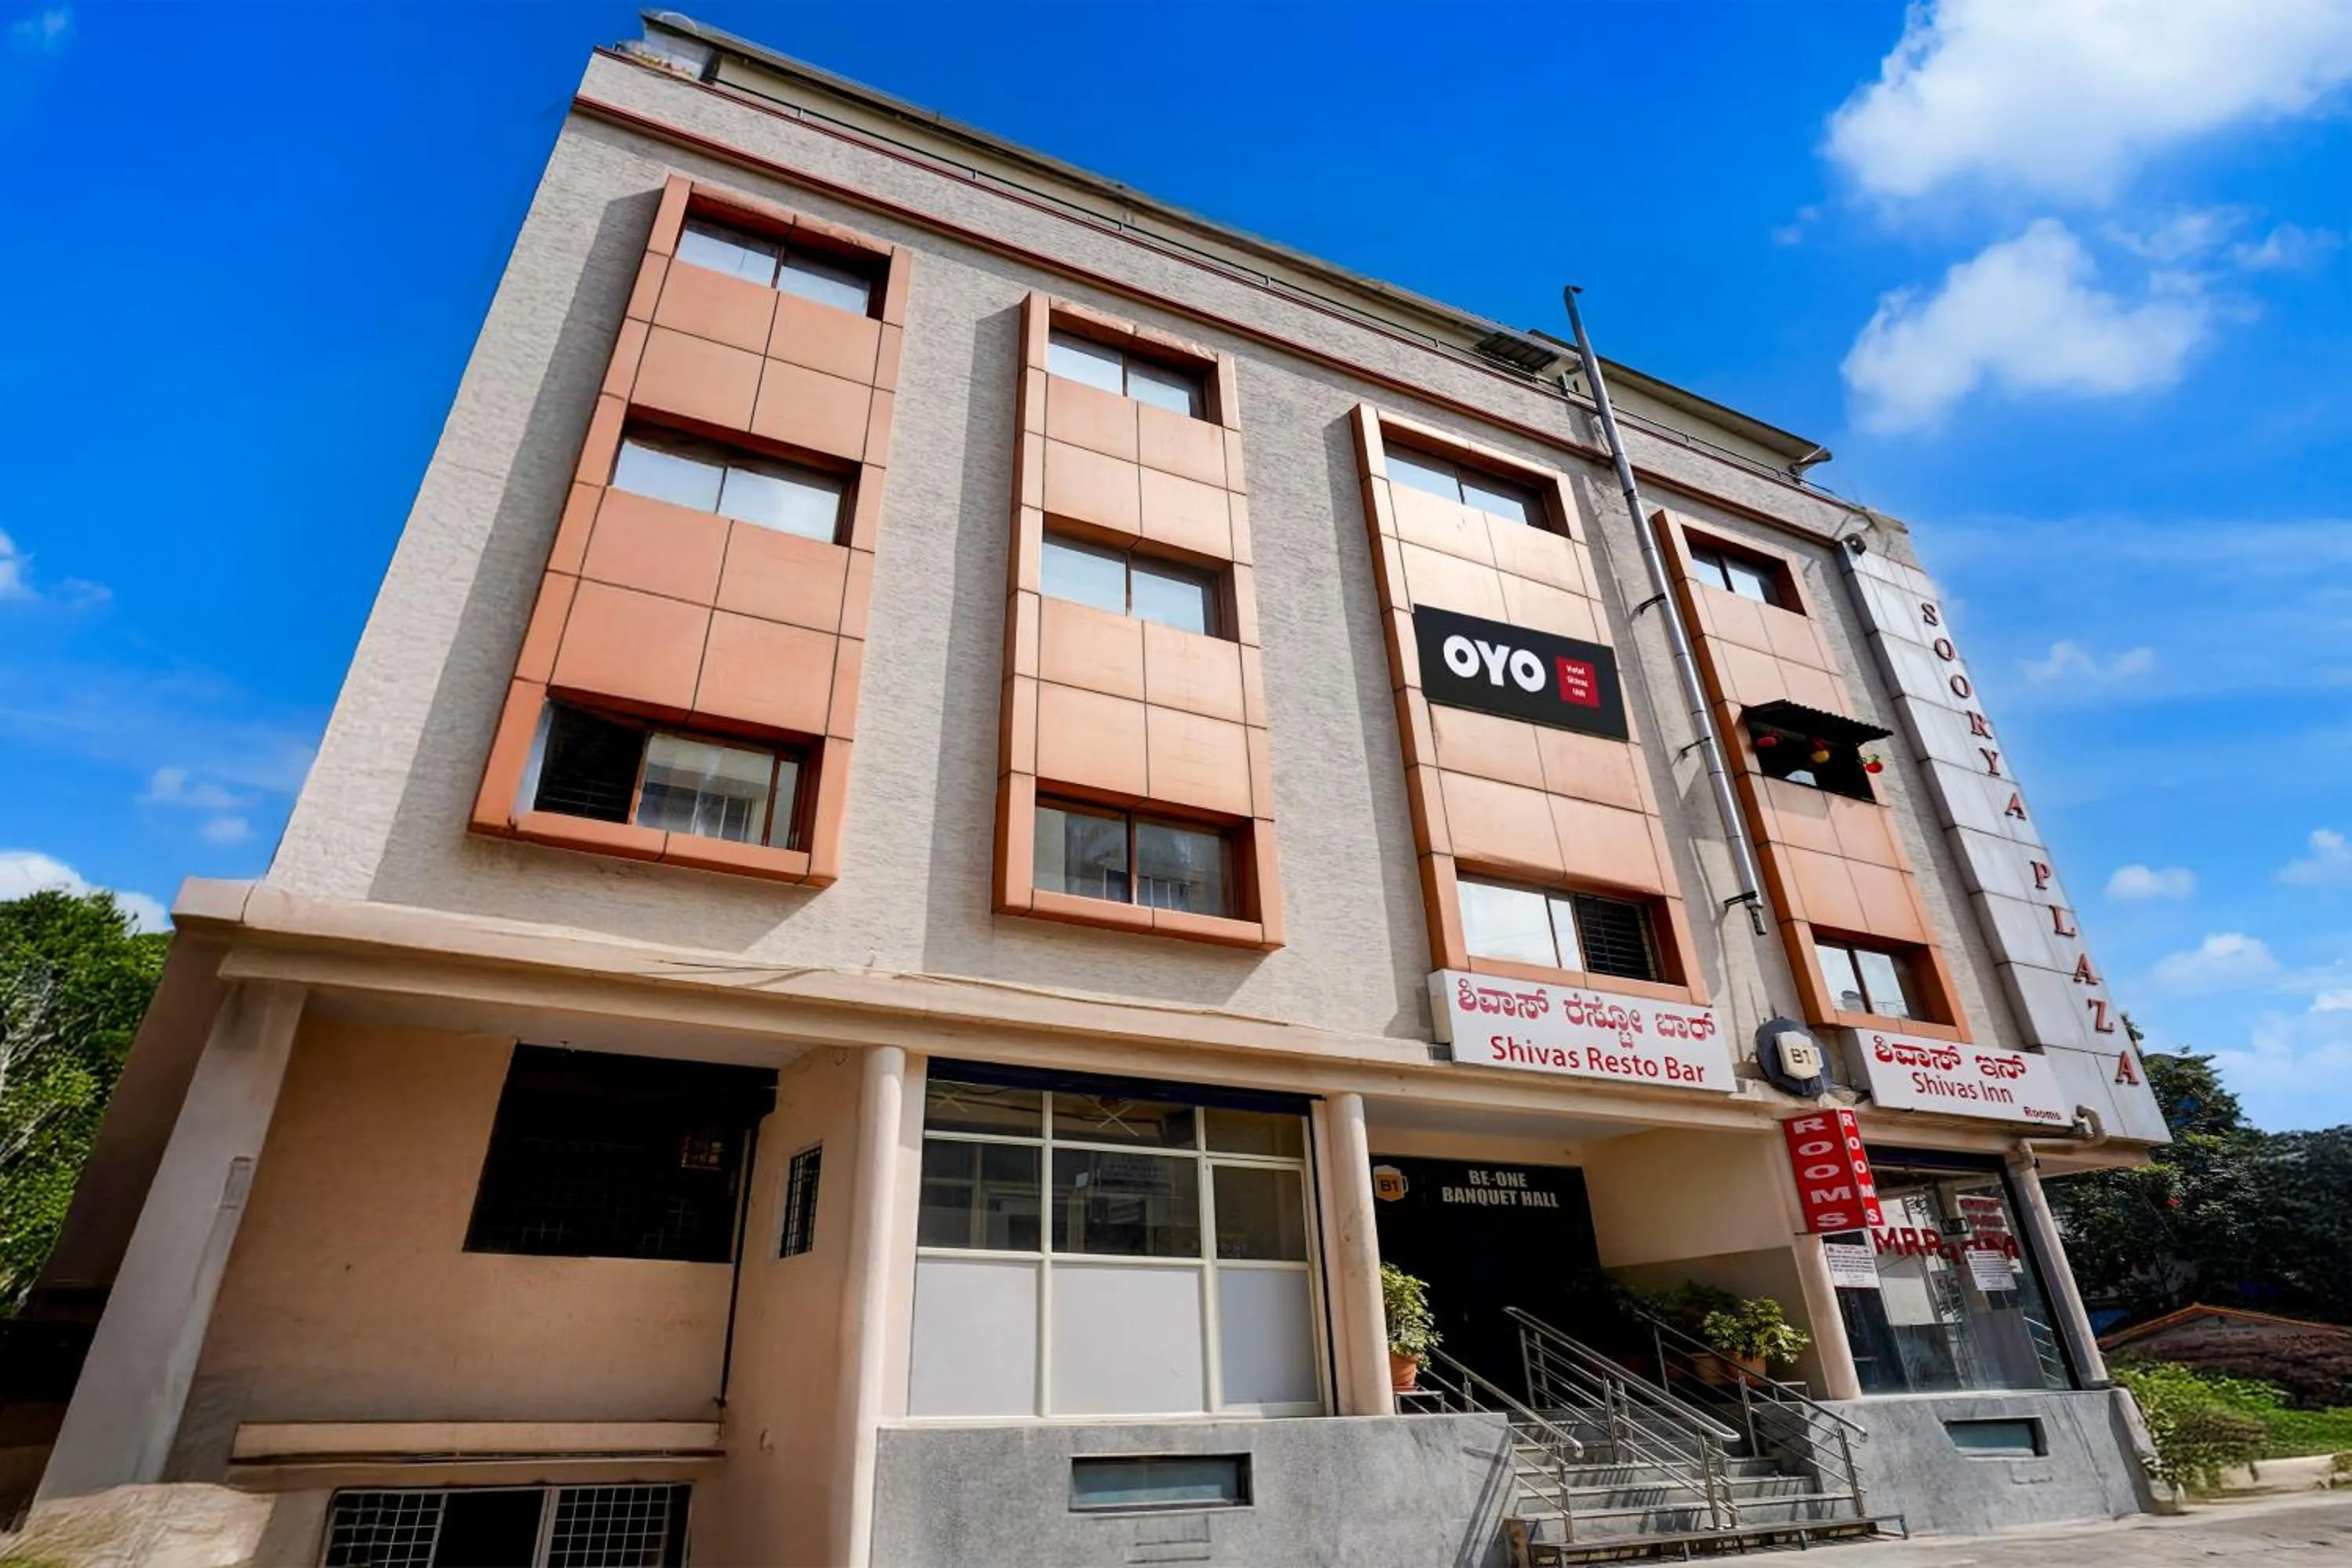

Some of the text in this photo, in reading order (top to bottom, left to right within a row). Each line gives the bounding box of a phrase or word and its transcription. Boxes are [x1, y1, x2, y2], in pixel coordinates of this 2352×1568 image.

[1443, 635, 1546, 692] OYO
[1921, 601, 2140, 1087] SOORYA PLAZA
[1457, 978, 1550, 1020] ಶಿವಾಸ್
[1655, 1012, 1716, 1041] ಬಾರ್
[1490, 1036, 1705, 1083] Shivas Resto Bar
[1791, 1047, 1813, 1065] B1
[1874, 1035, 2027, 1080] ಶಿವಾಸ್ ಇನ್
[1911, 1071, 2014, 1104] Shivas Inn
[1380, 1178, 1399, 1193] B1
[1468, 1170, 1528, 1188] BE-ONE
[1792, 1117, 1852, 1228] ROOMS
[1842, 1112, 1880, 1223] ROOMS
[1442, 1186, 1559, 1208] BANQUET HALL
